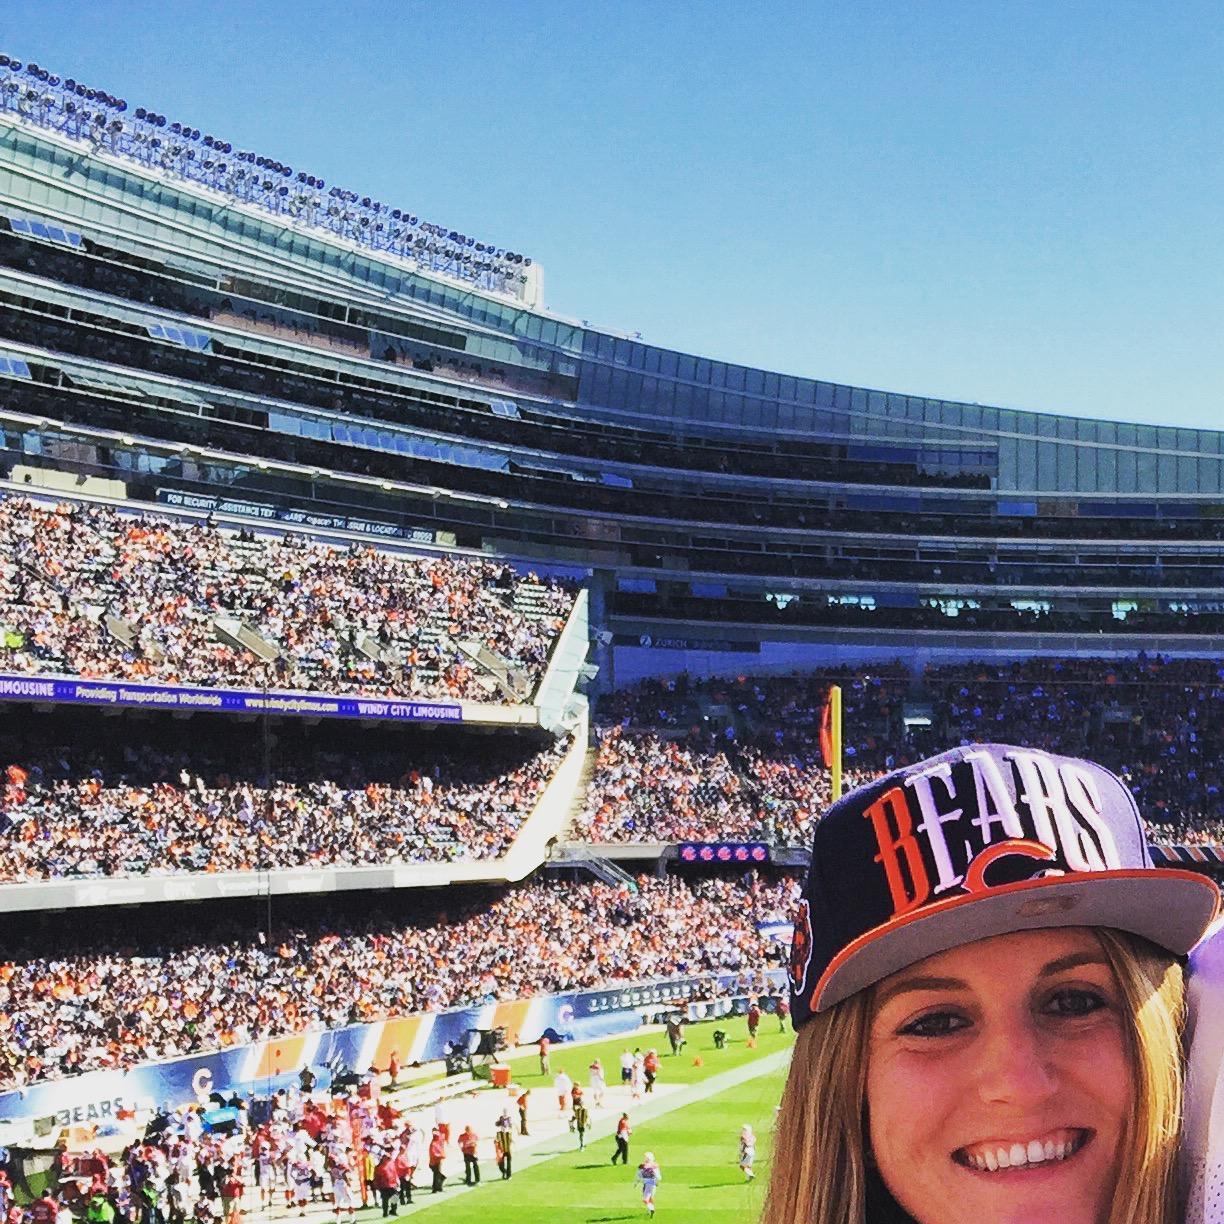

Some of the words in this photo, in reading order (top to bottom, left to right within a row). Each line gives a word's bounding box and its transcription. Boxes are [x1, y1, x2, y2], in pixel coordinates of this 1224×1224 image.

[0, 680, 55, 697] IMOUSINE
[75, 684, 117, 702] Providing
[119, 688, 178, 705] Transportation
[179, 692, 223, 706] Worldwide
[358, 702, 389, 716] WINDY
[390, 703, 412, 717] CITY
[412, 705, 461, 720] LIMOUSINE
[861, 749, 1123, 924] BEARS
